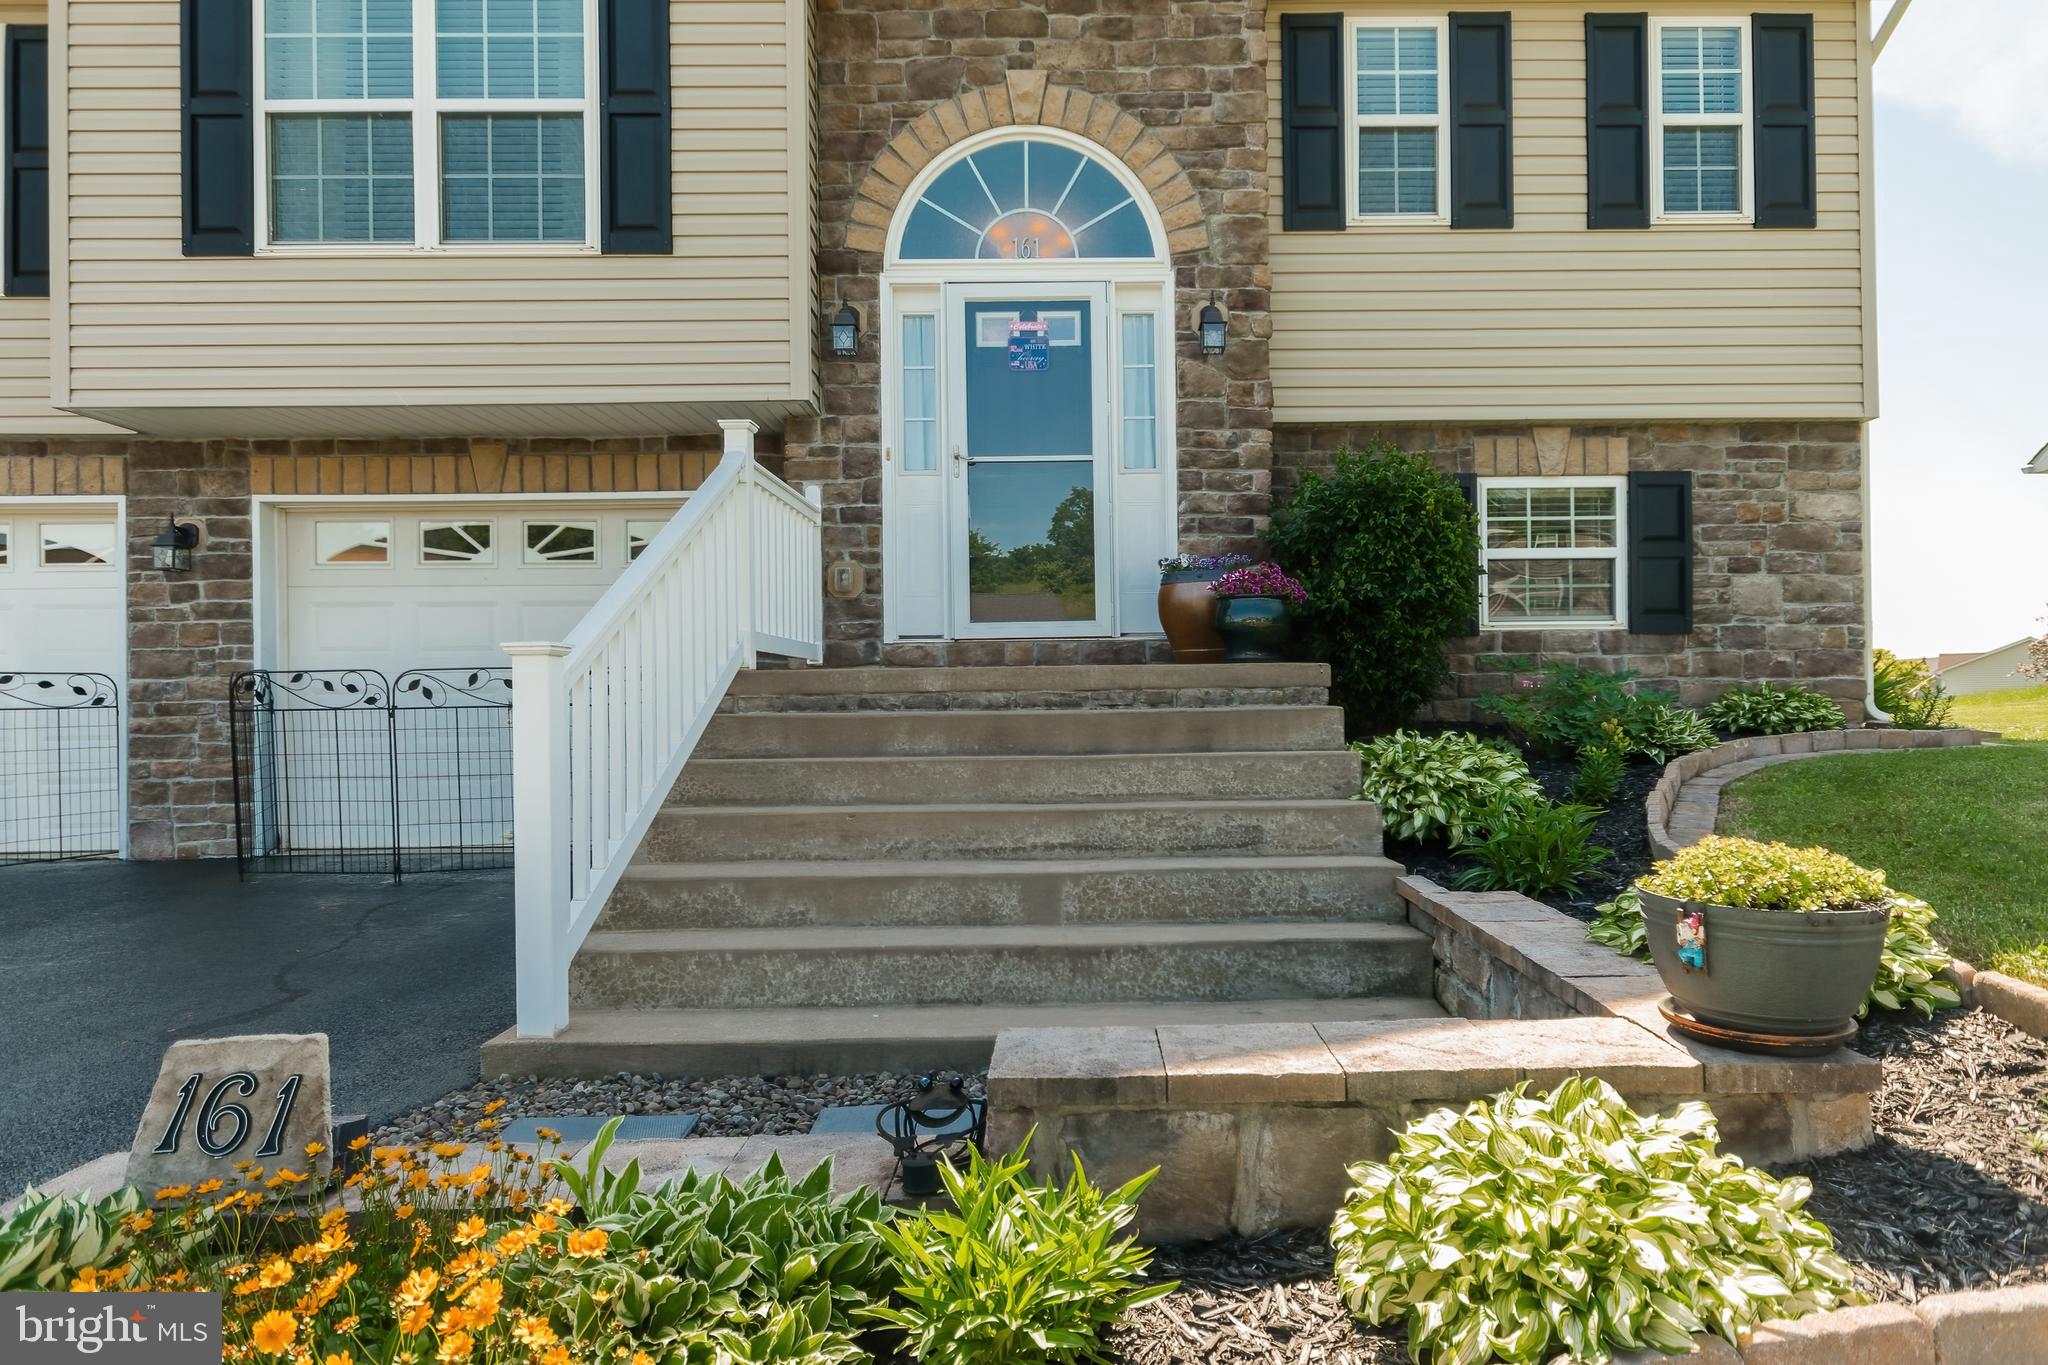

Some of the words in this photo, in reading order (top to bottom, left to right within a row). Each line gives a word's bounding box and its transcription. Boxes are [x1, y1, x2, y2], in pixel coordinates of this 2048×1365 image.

[1013, 237, 1040, 258] 161
[1024, 361, 1038, 369] USA
[152, 1072, 303, 1159] 161
